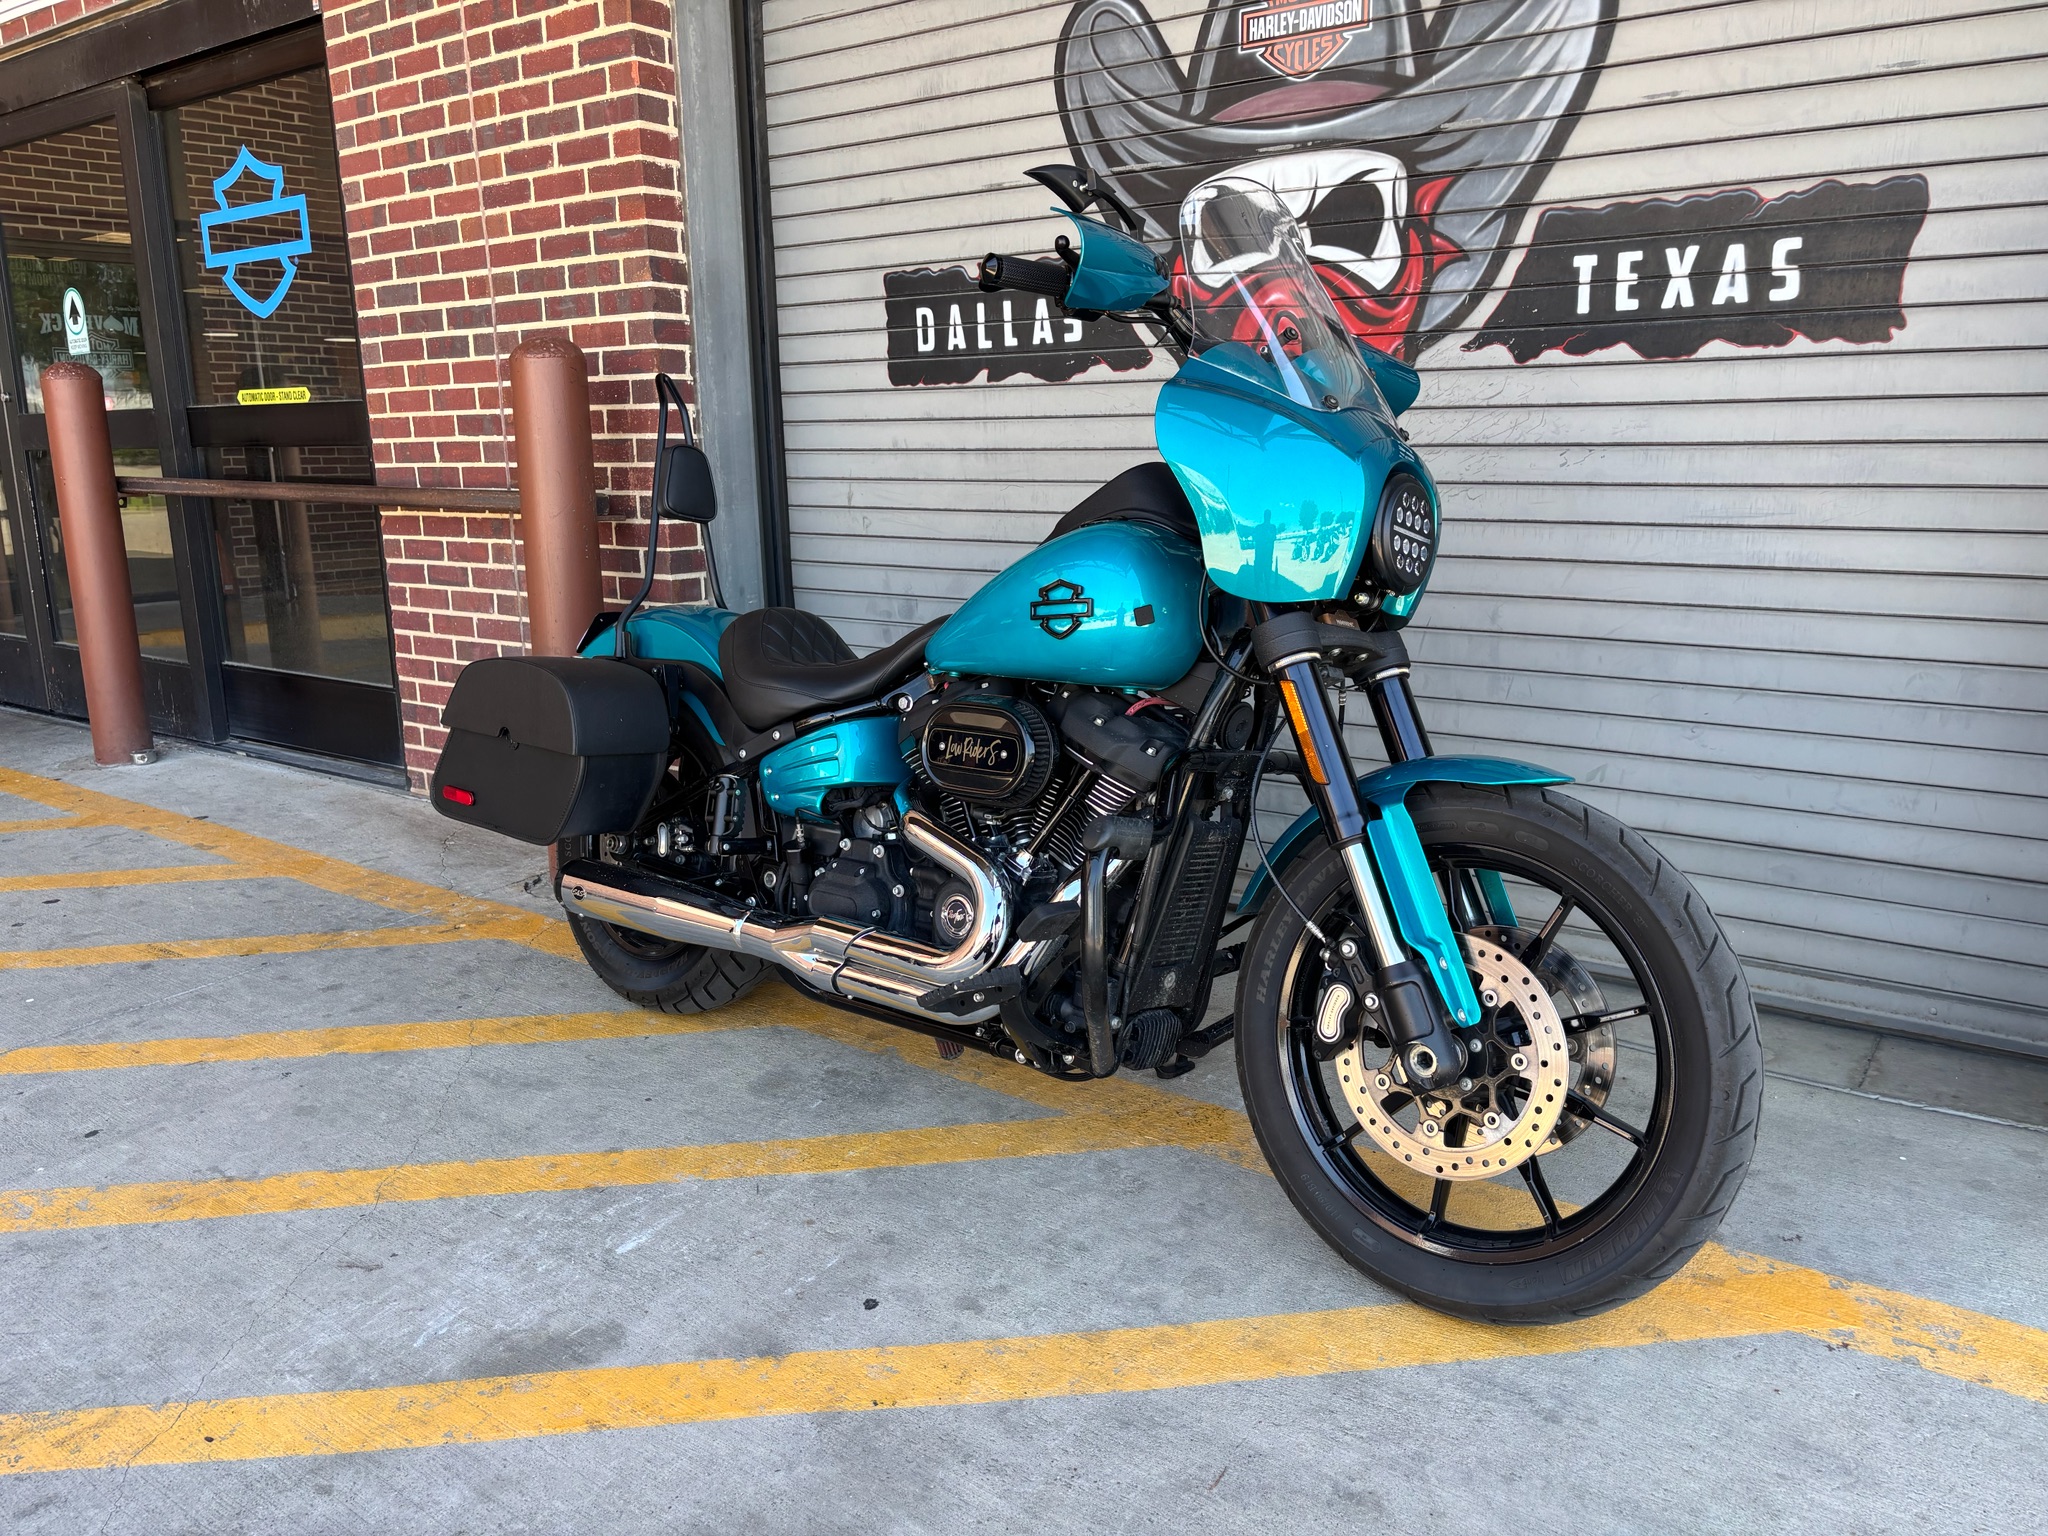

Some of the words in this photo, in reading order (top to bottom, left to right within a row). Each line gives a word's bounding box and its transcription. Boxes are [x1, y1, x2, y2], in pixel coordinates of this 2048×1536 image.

[1249, 0, 1363, 42] HARLEY-DAVIDSON
[1273, 35, 1333, 71] CYCLES
[1573, 237, 1803, 314] TEXAS
[915, 298, 1083, 352] DALLAS
[241, 391, 264, 403] AUTOMATIC
[264, 391, 276, 402] DOOR
[279, 390, 292, 401] STAND
[293, 389, 307, 400] CLEAR
[1570, 857, 1633, 912] SCORCHER
[1563, 1195, 1663, 1283] MICHELIN
